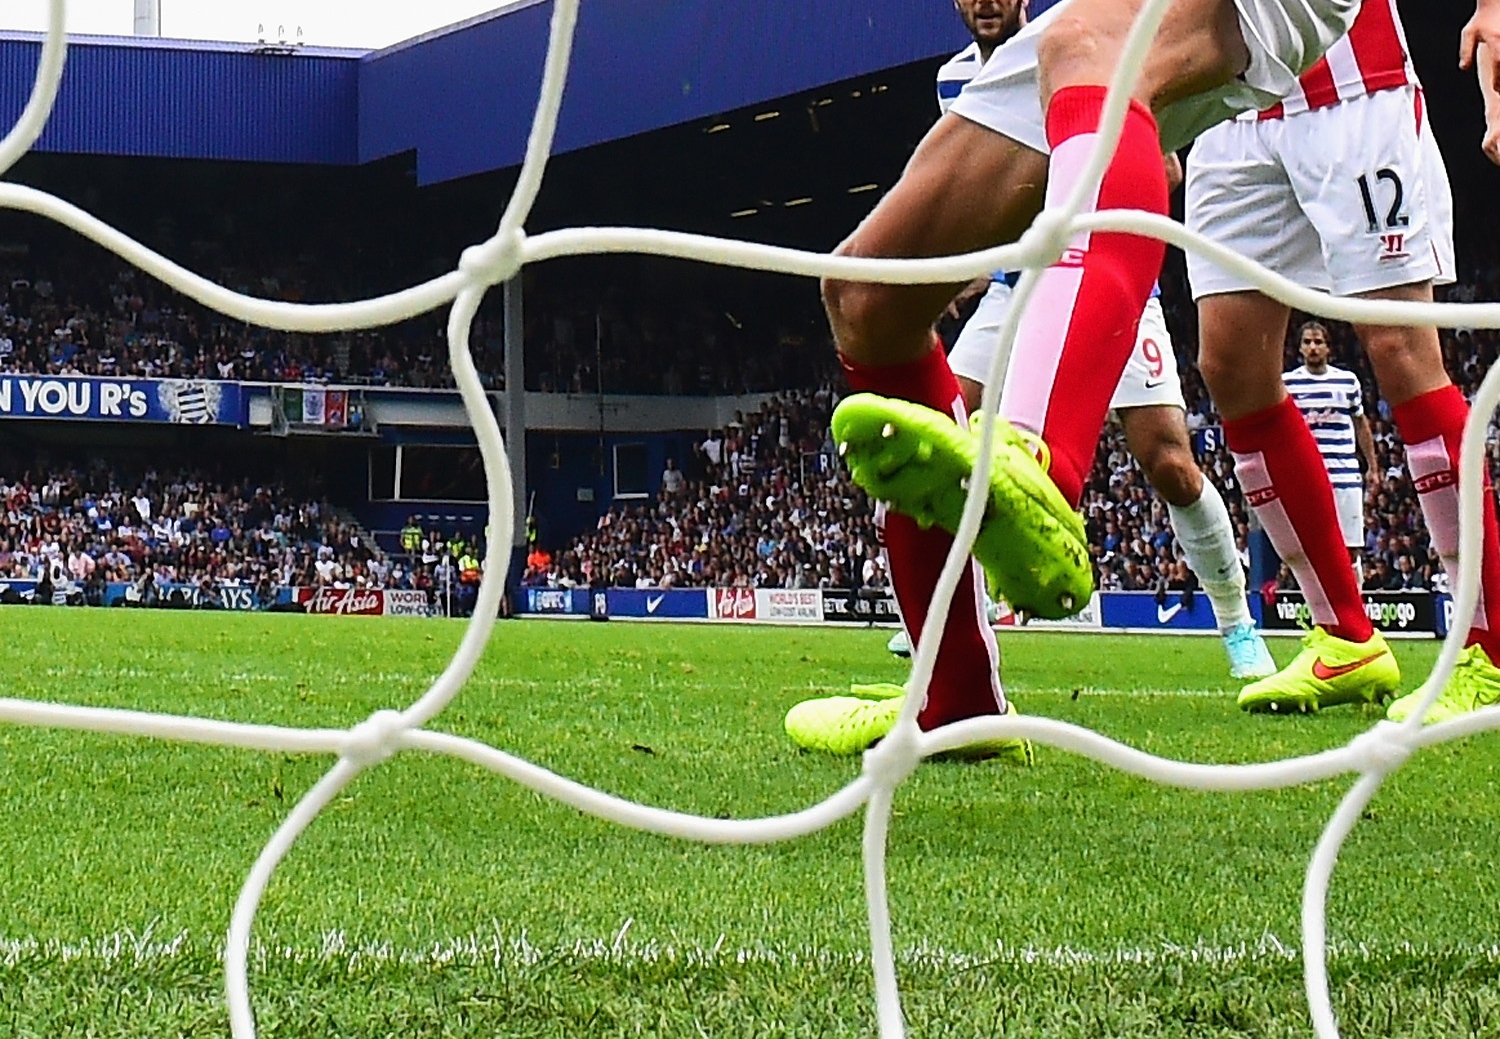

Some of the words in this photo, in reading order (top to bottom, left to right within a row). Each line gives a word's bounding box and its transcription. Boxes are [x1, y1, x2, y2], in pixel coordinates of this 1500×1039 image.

[1355, 167, 1410, 234] 12
[1142, 338, 1163, 378] 9
[19, 380, 91, 414] YOU
[1276, 596, 1311, 627] viago
[1365, 596, 1415, 628] iagogo
